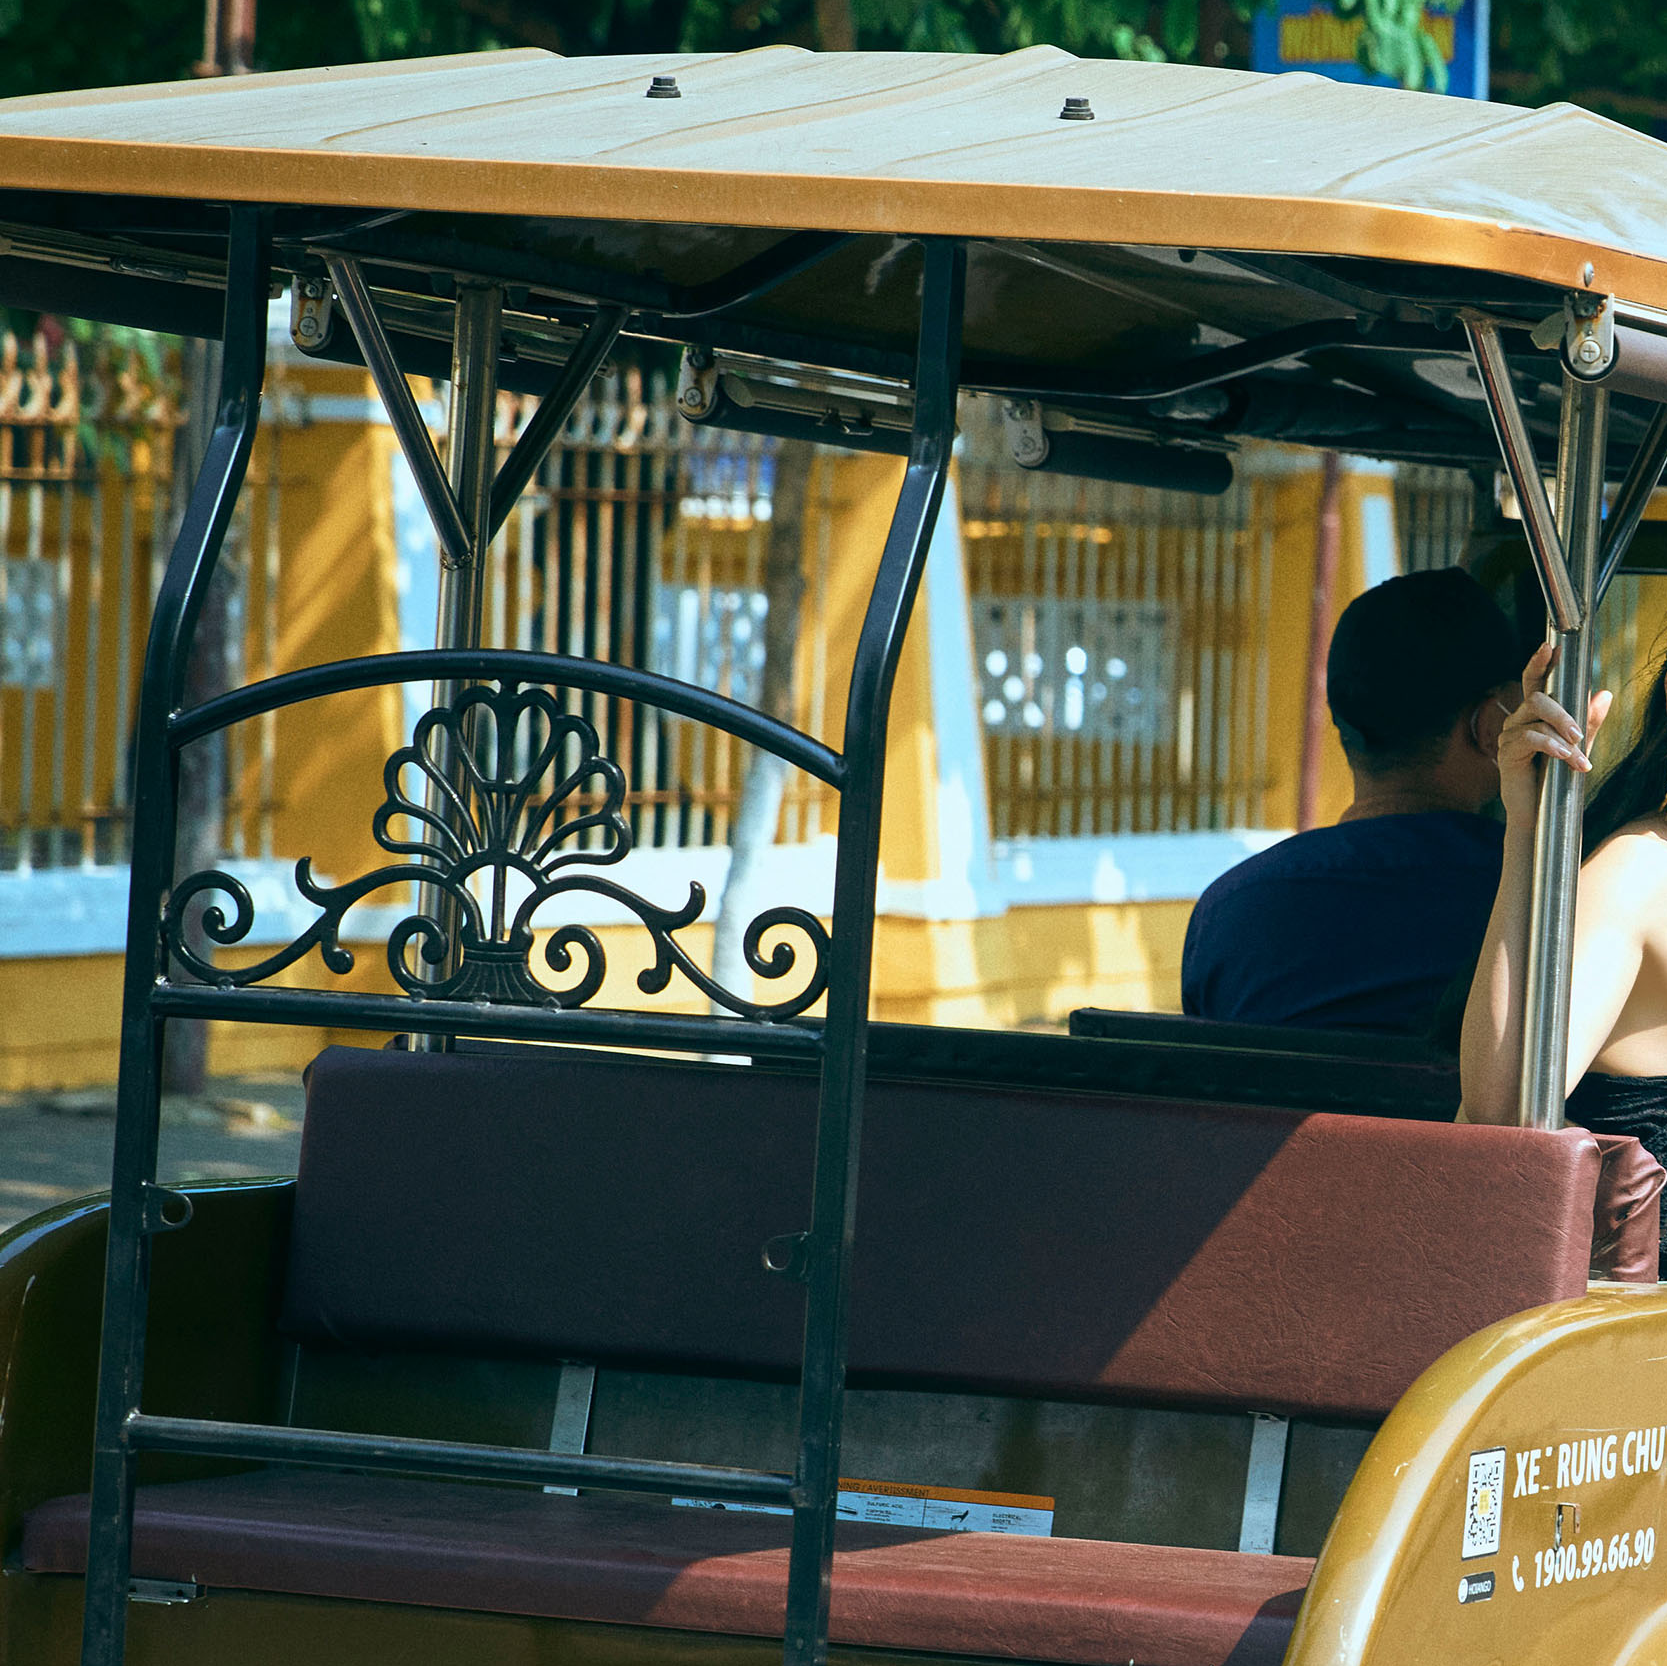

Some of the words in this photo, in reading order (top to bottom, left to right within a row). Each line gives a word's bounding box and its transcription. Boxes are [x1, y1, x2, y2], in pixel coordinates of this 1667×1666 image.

[1512, 1449, 1542, 1498] XE
[1542, 1435, 1617, 1489] RUNG
[1534, 1527, 1655, 1588] 1900.99.66.90
